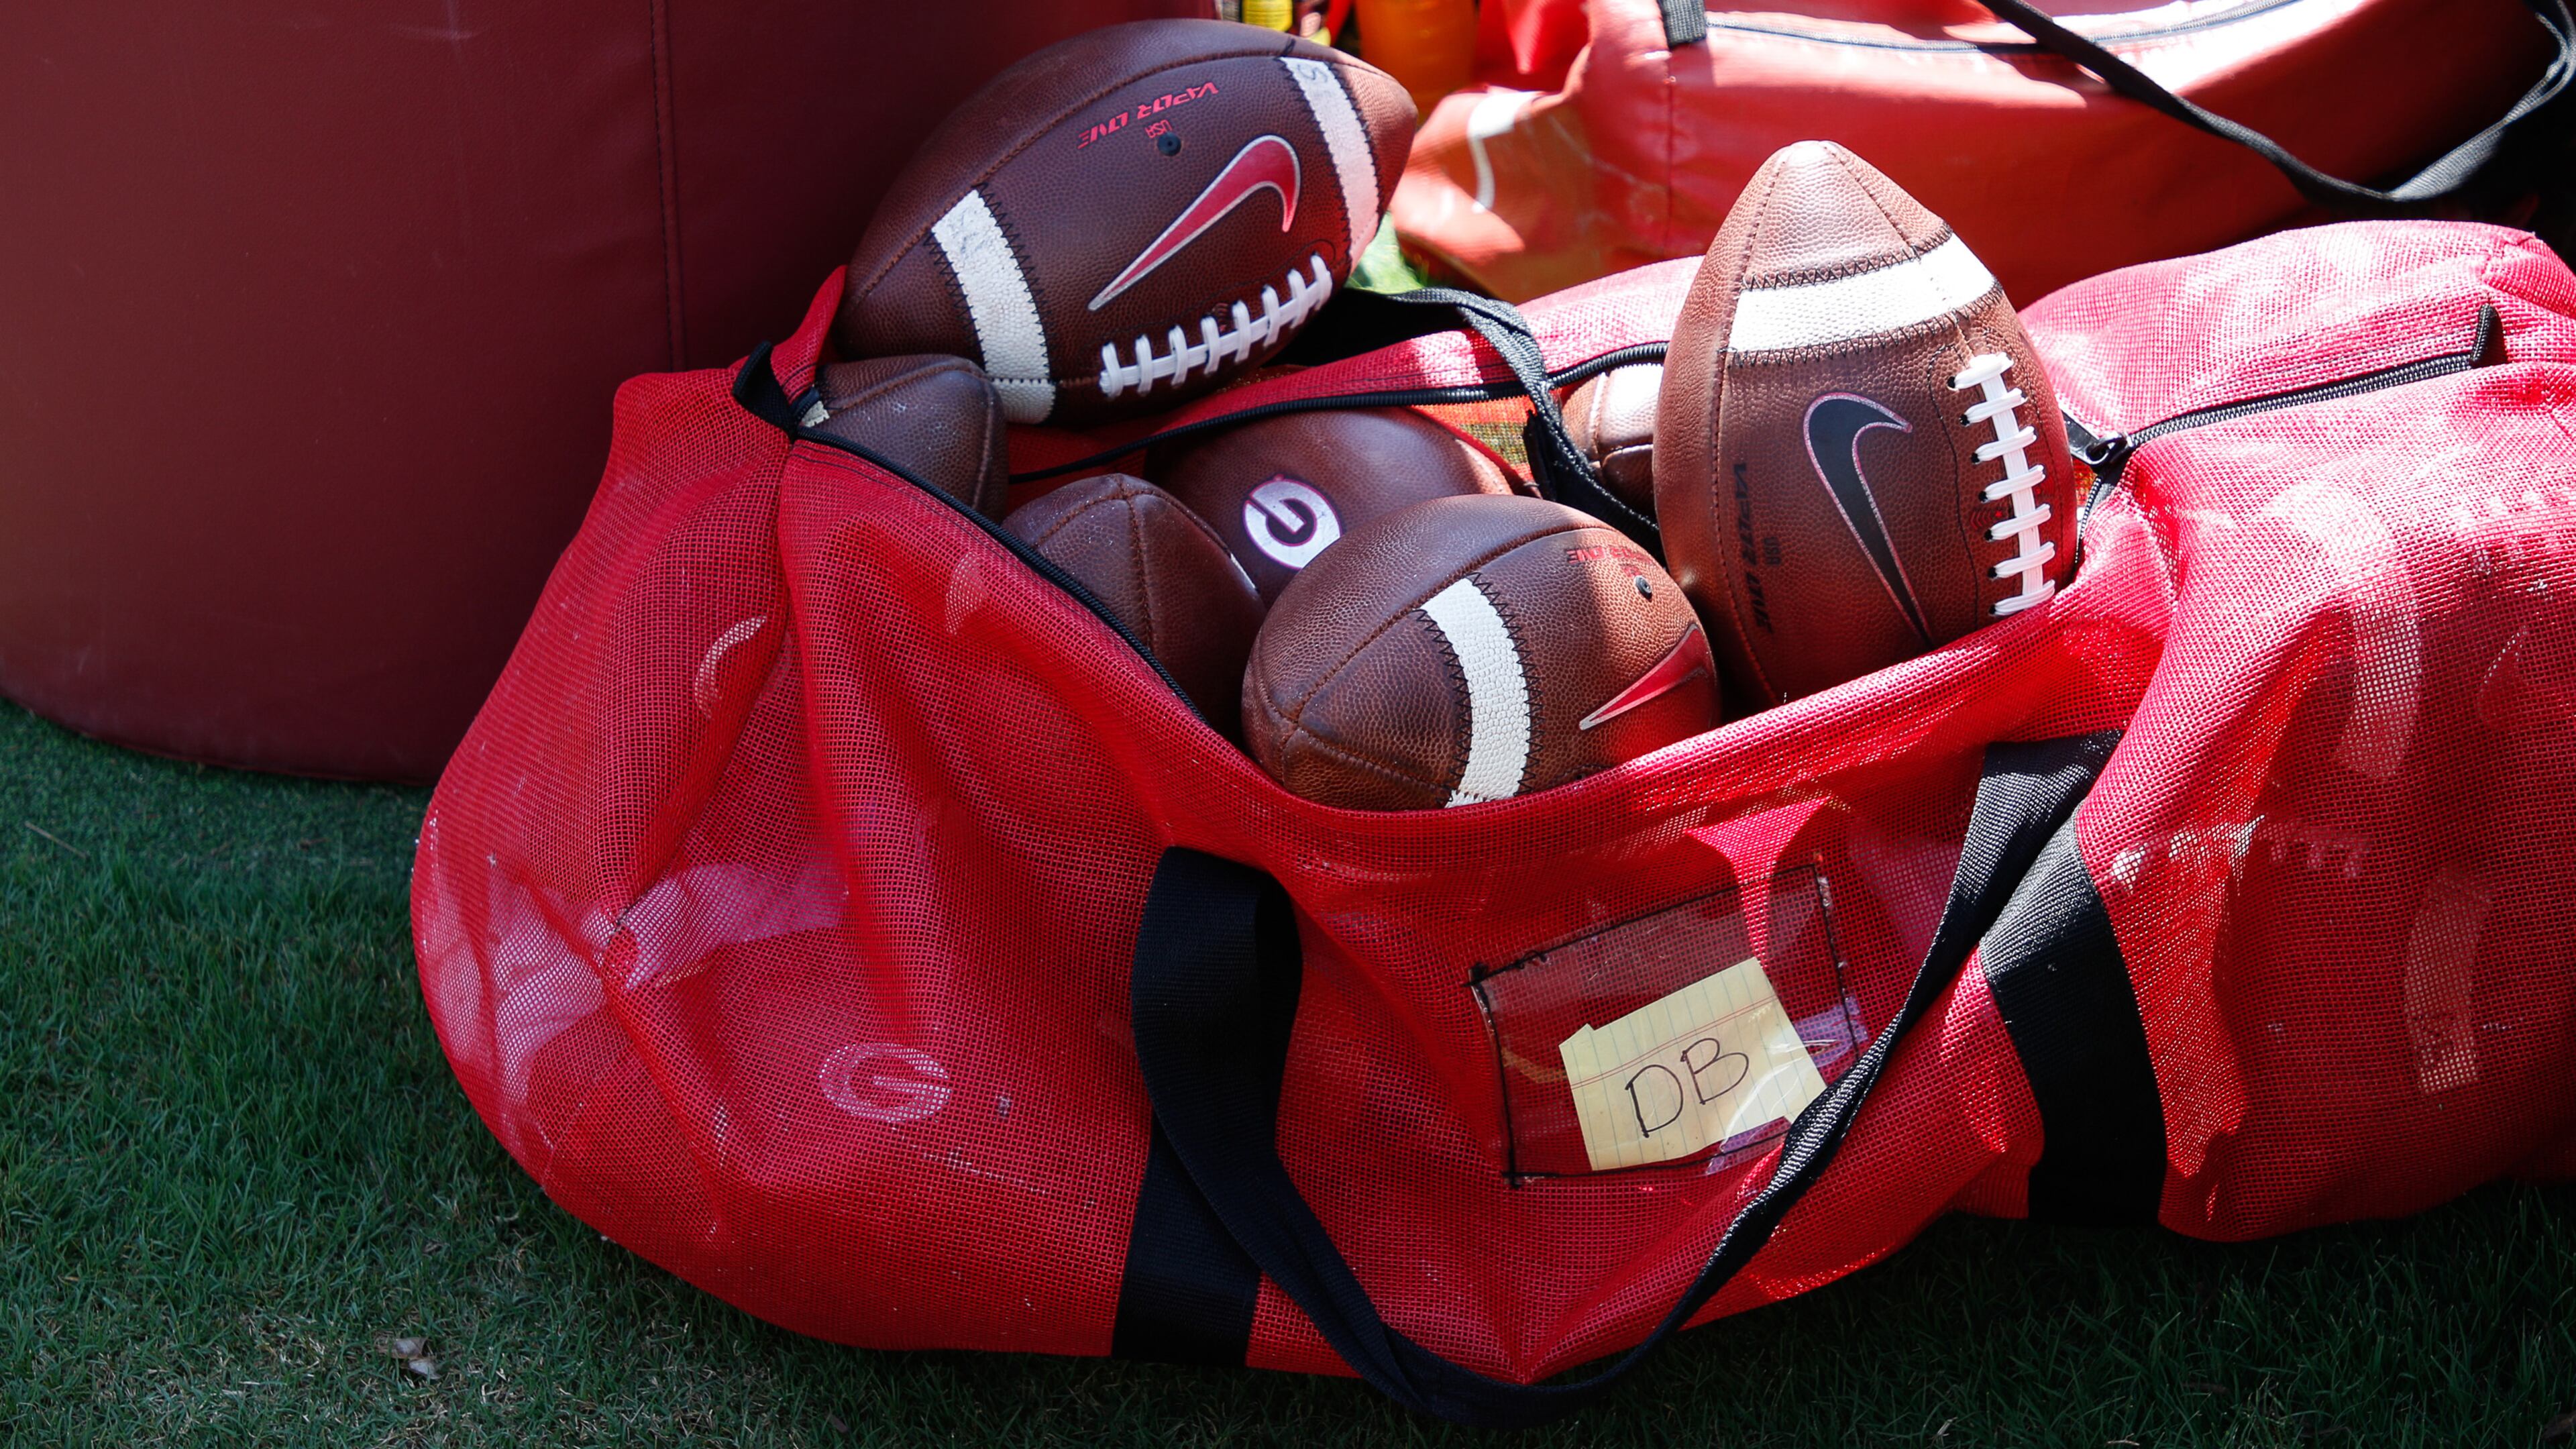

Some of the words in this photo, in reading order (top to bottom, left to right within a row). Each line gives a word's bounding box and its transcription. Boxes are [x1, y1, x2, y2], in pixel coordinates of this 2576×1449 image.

[1136, 81, 1219, 120] VAPOR
[1077, 111, 1129, 150] ONE
[1144, 119, 1173, 140] USA
[1242, 474, 1343, 571] G
[1566, 546, 1606, 564] ONE
[1733, 462, 1757, 566] VAPOR
[1746, 572, 1774, 634] ONE
[1625, 1038, 1750, 1138] DB
